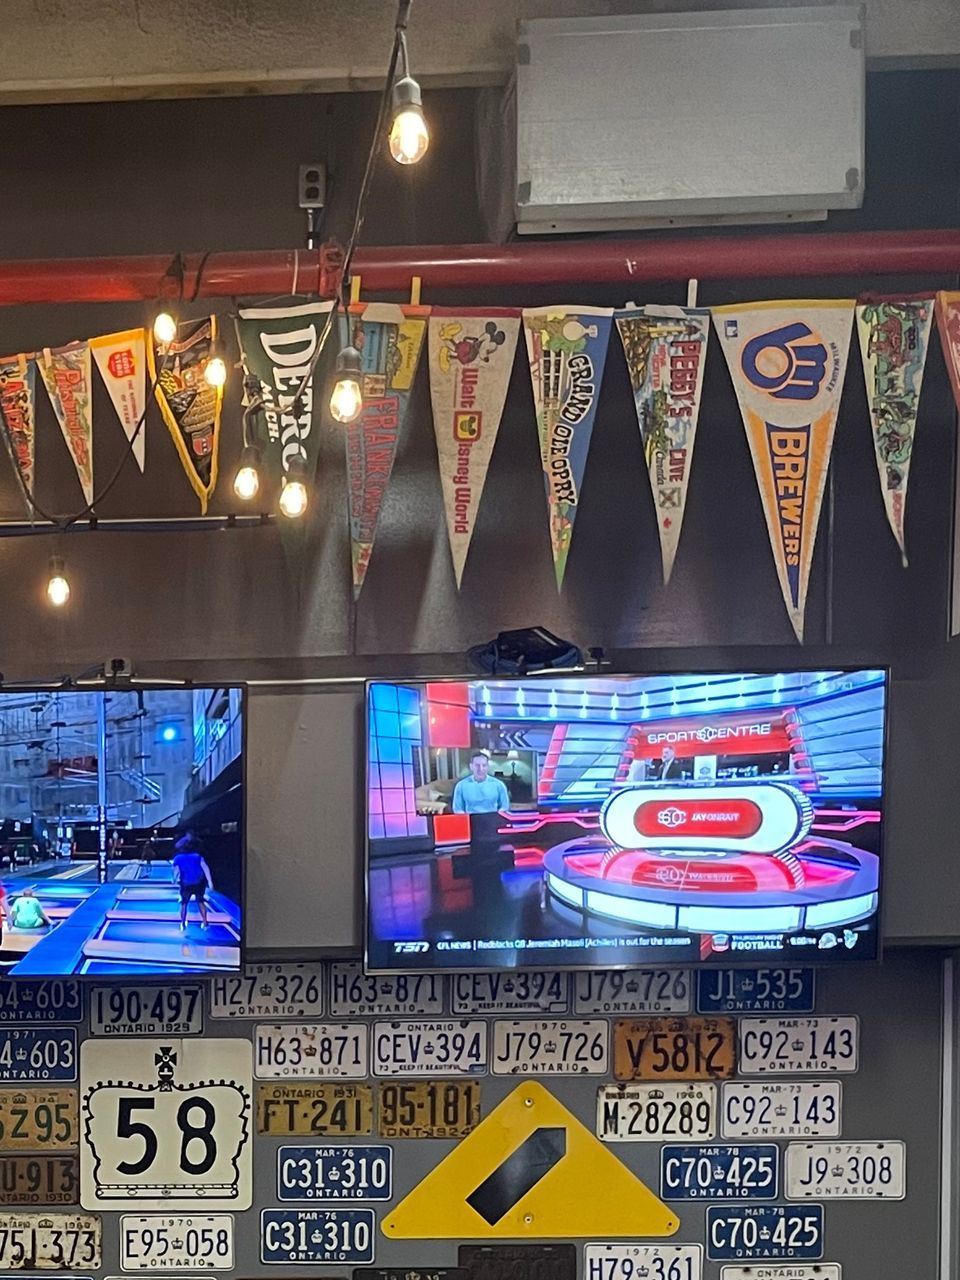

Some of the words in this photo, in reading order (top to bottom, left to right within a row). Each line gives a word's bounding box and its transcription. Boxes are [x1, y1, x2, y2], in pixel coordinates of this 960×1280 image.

[669, 340, 701, 418] PEGGY'S
[826, 342, 840, 393] MILWAUKEE
[458, 367, 479, 408] Walt
[560, 354, 593, 423] GRAND
[551, 426, 572, 455] OLE
[551, 458, 577, 505] OPRY
[655, 451, 666, 485] Canada
[454, 487, 471, 534] World
[770, 431, 806, 566] BREWERS
[394, 942, 429, 953] TSN
[731, 941, 784, 949] FOOTBALL
[104, 1023, 155, 1033] ONTARIO
[161, 1023, 190, 1032] 1929
[778, 1019, 818, 1028] MAR-73
[30, 1039, 74, 1069] 603
[258, 1036, 302, 1066] H63
[320, 1036, 361, 1065] 871
[377, 1034, 420, 1063] CEV
[436, 1033, 481, 1062] 394
[497, 1033, 541, 1062] J79
[559, 1033, 604, 1061] 726
[744, 1030, 789, 1060] C92
[808, 1029, 853, 1060] 143
[116, 1096, 217, 1175] 58
[282, 1159, 324, 1189] C31
[341, 1158, 387, 1188] 310
[666, 1158, 712, 1188] C70
[727, 1157, 772, 1187] 425
[800, 1157, 828, 1186] J9
[847, 1156, 892, 1184] 308
[126, 1229, 169, 1258] E95
[186, 1229, 229, 1256] 058
